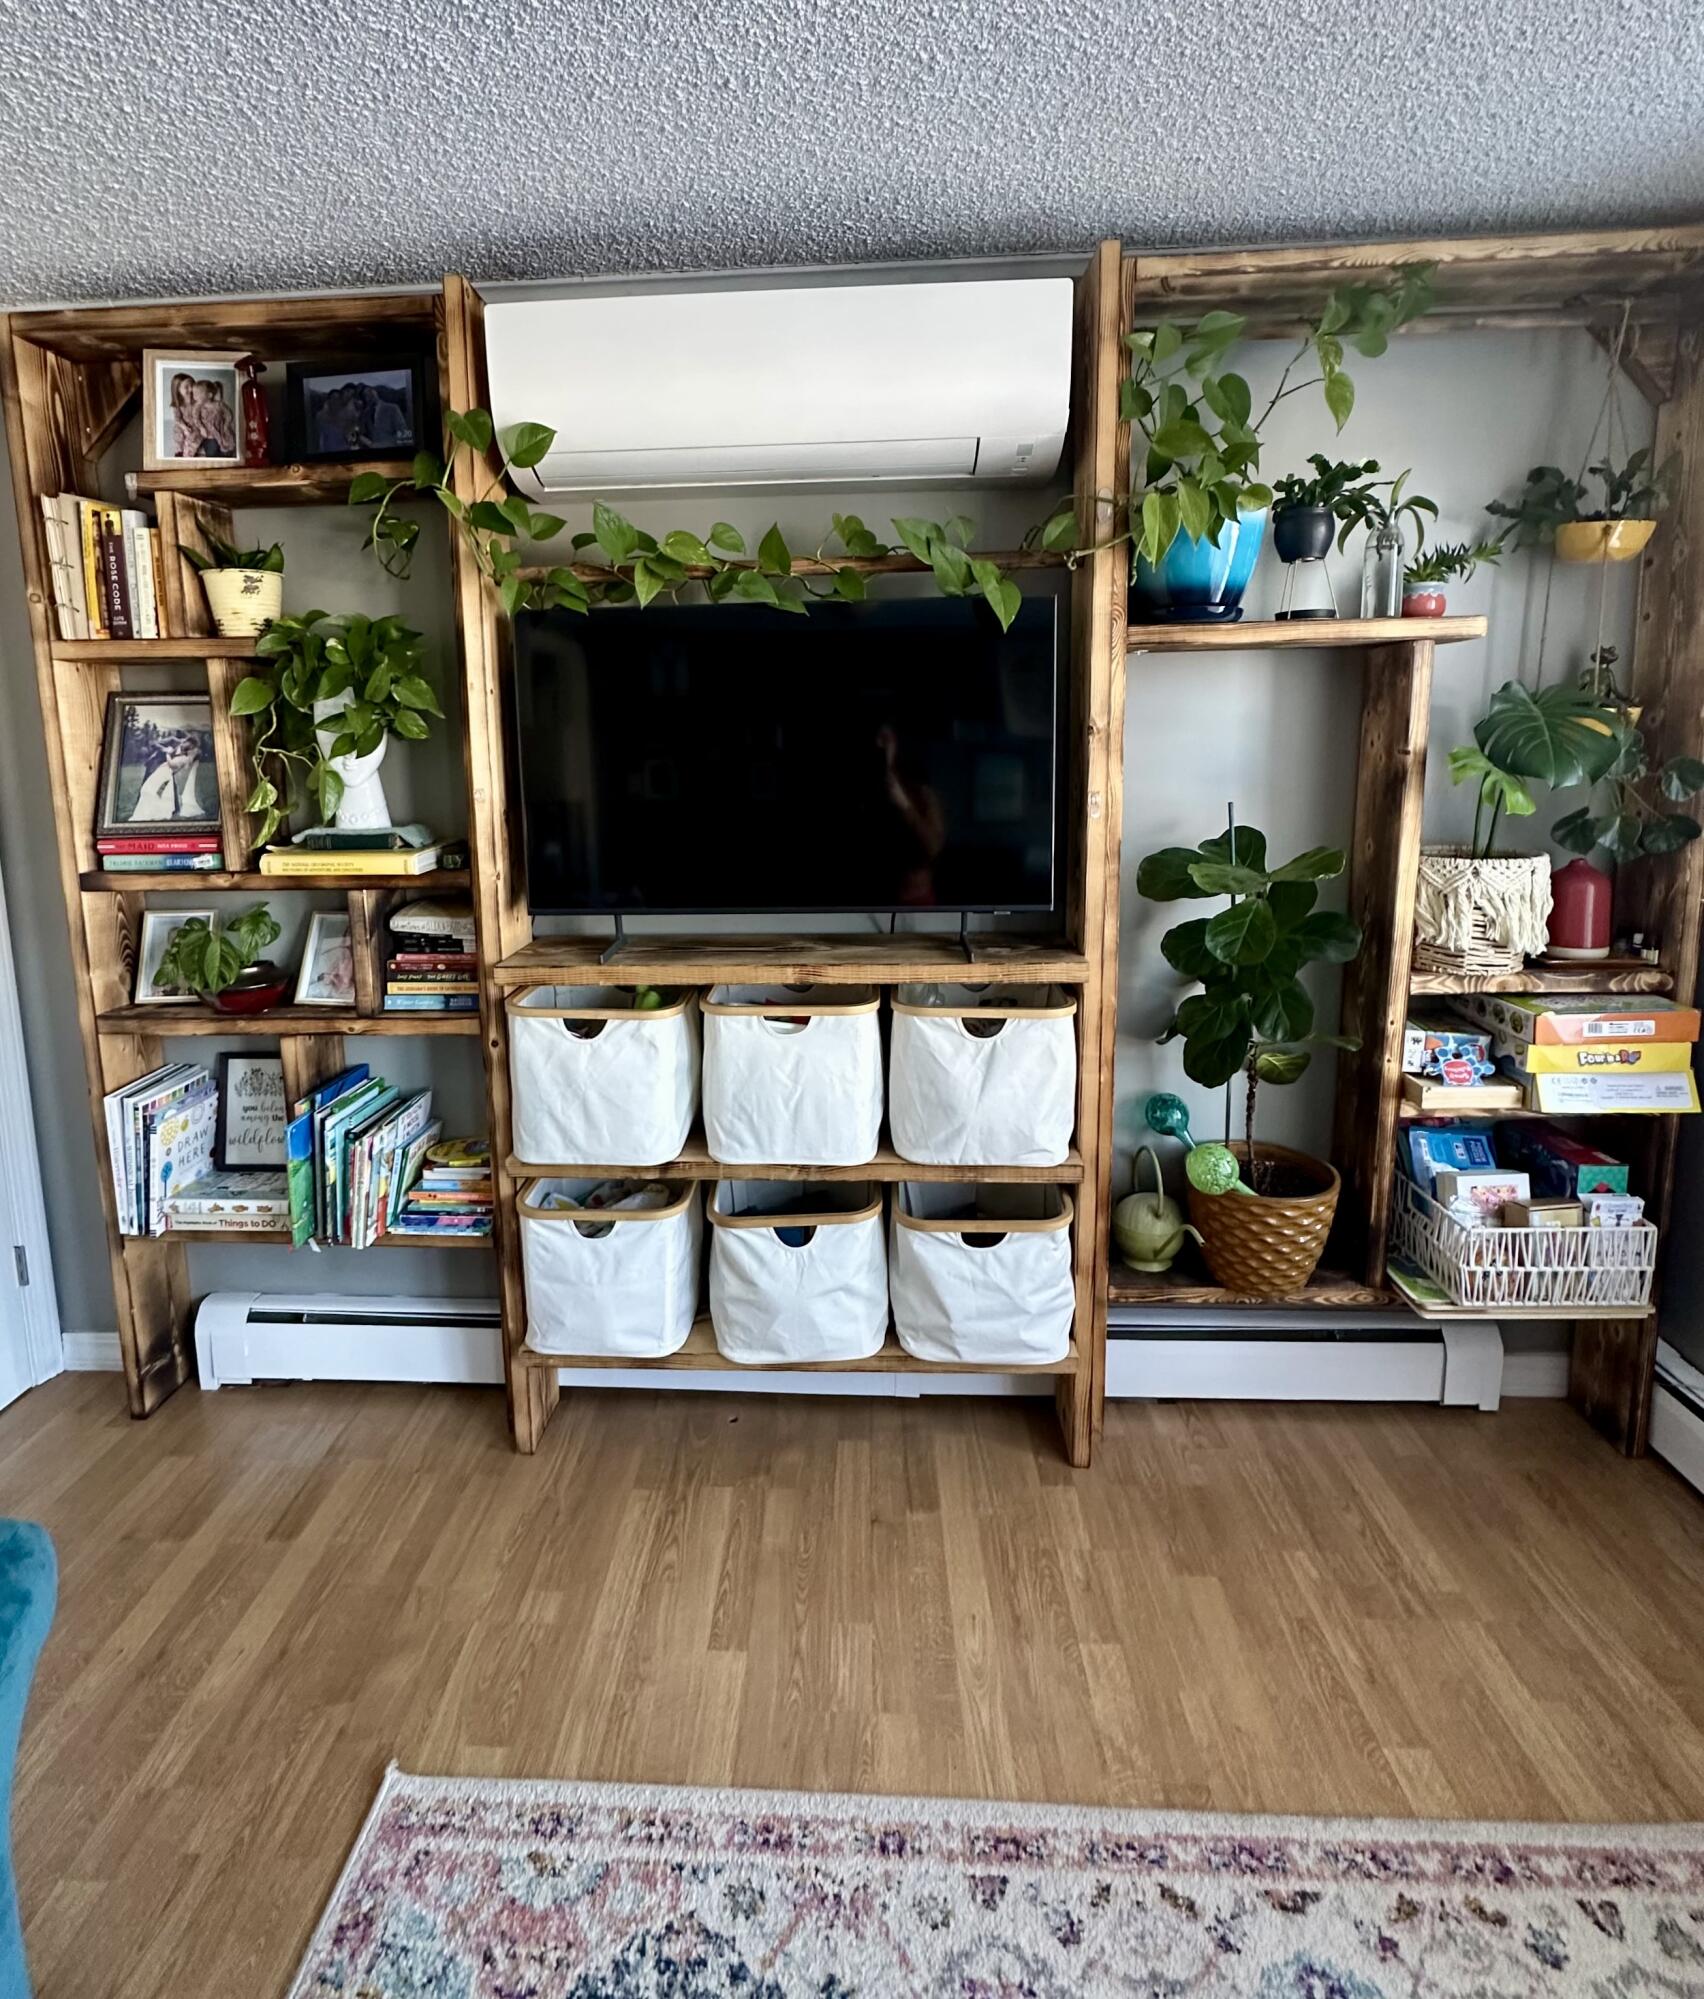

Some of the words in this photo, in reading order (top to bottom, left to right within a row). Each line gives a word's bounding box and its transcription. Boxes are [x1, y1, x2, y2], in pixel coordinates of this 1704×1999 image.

[109, 556, 119, 581] ROSE
[111, 583, 122, 611] CODE
[127, 840, 155, 851] MAID
[1578, 1051, 1605, 1066] Four
[242, 1105, 258, 1114] you
[177, 1126, 209, 1153] DRAW
[178, 1143, 206, 1168] HERE
[218, 1219, 248, 1229] Things
[250, 1219, 261, 1228] to
[261, 1219, 277, 1228] DO
